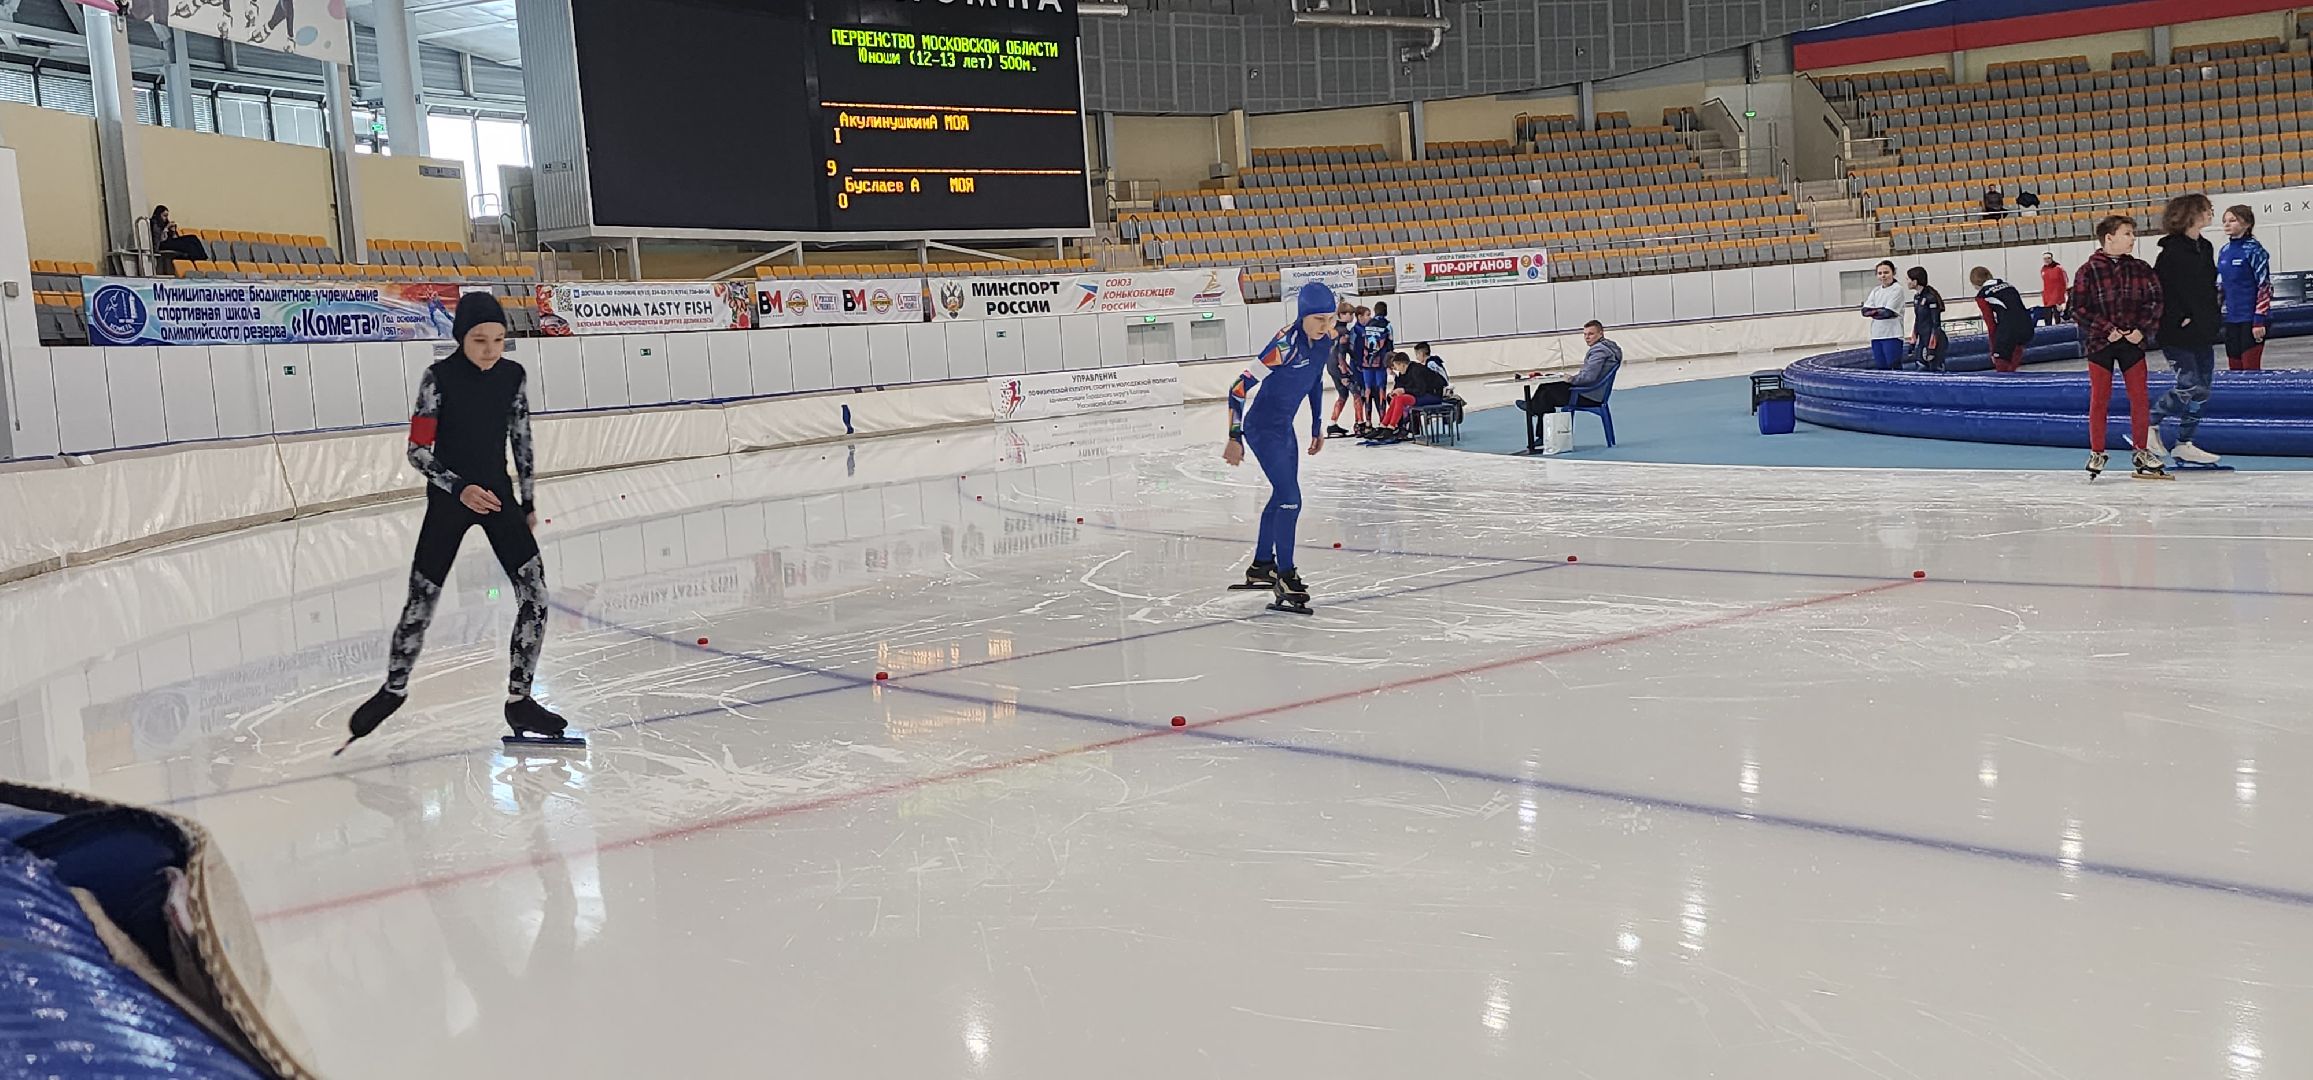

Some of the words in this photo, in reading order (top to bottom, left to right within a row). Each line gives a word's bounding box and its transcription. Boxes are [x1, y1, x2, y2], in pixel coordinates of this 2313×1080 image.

[831, 29, 915, 49] ПЕРВЕНСТВО
[1006, 40, 1059, 58] ОБЛАСТИ
[858, 47, 901, 65] Юноши
[909, 50, 956, 68] (12-13
[962, 54, 993, 69] лет)
[1000, 55, 1037, 72] 500м.
[944, 115, 970, 131] МОЯ
[827, 160, 837, 177] 9
[844, 177, 904, 195] Буслаев
[910, 177, 920, 193] А
[949, 177, 975, 193] МОЯ
[1430, 259, 1513, 274] ЛОР-ОРГАНОВ
[971, 281, 1060, 297] МИНСПОРТ
[1105, 278, 1132, 288] СОЮЗ
[153, 283, 245, 305] Муниципальное
[249, 285, 311, 302] бюджетное
[315, 289, 379, 306] учреждение
[1103, 287, 1175, 300] КОНЬКОБЕЖЦЕВ
[574, 303, 641, 318] KOLOMNA
[644, 302, 680, 316] TASTY
[685, 301, 713, 315] FISH
[986, 301, 1051, 316] РОССИИ
[1101, 301, 1137, 311] РОССИИ
[157, 307, 221, 325] спортивная
[225, 307, 261, 321] школа
[292, 309, 380, 336] «Комета»
[382, 314, 394, 323] Год
[161, 324, 240, 341] олимпийского
[244, 324, 286, 342] резерва
[1072, 371, 1118, 383] УПРАВЛЕНИЕ
